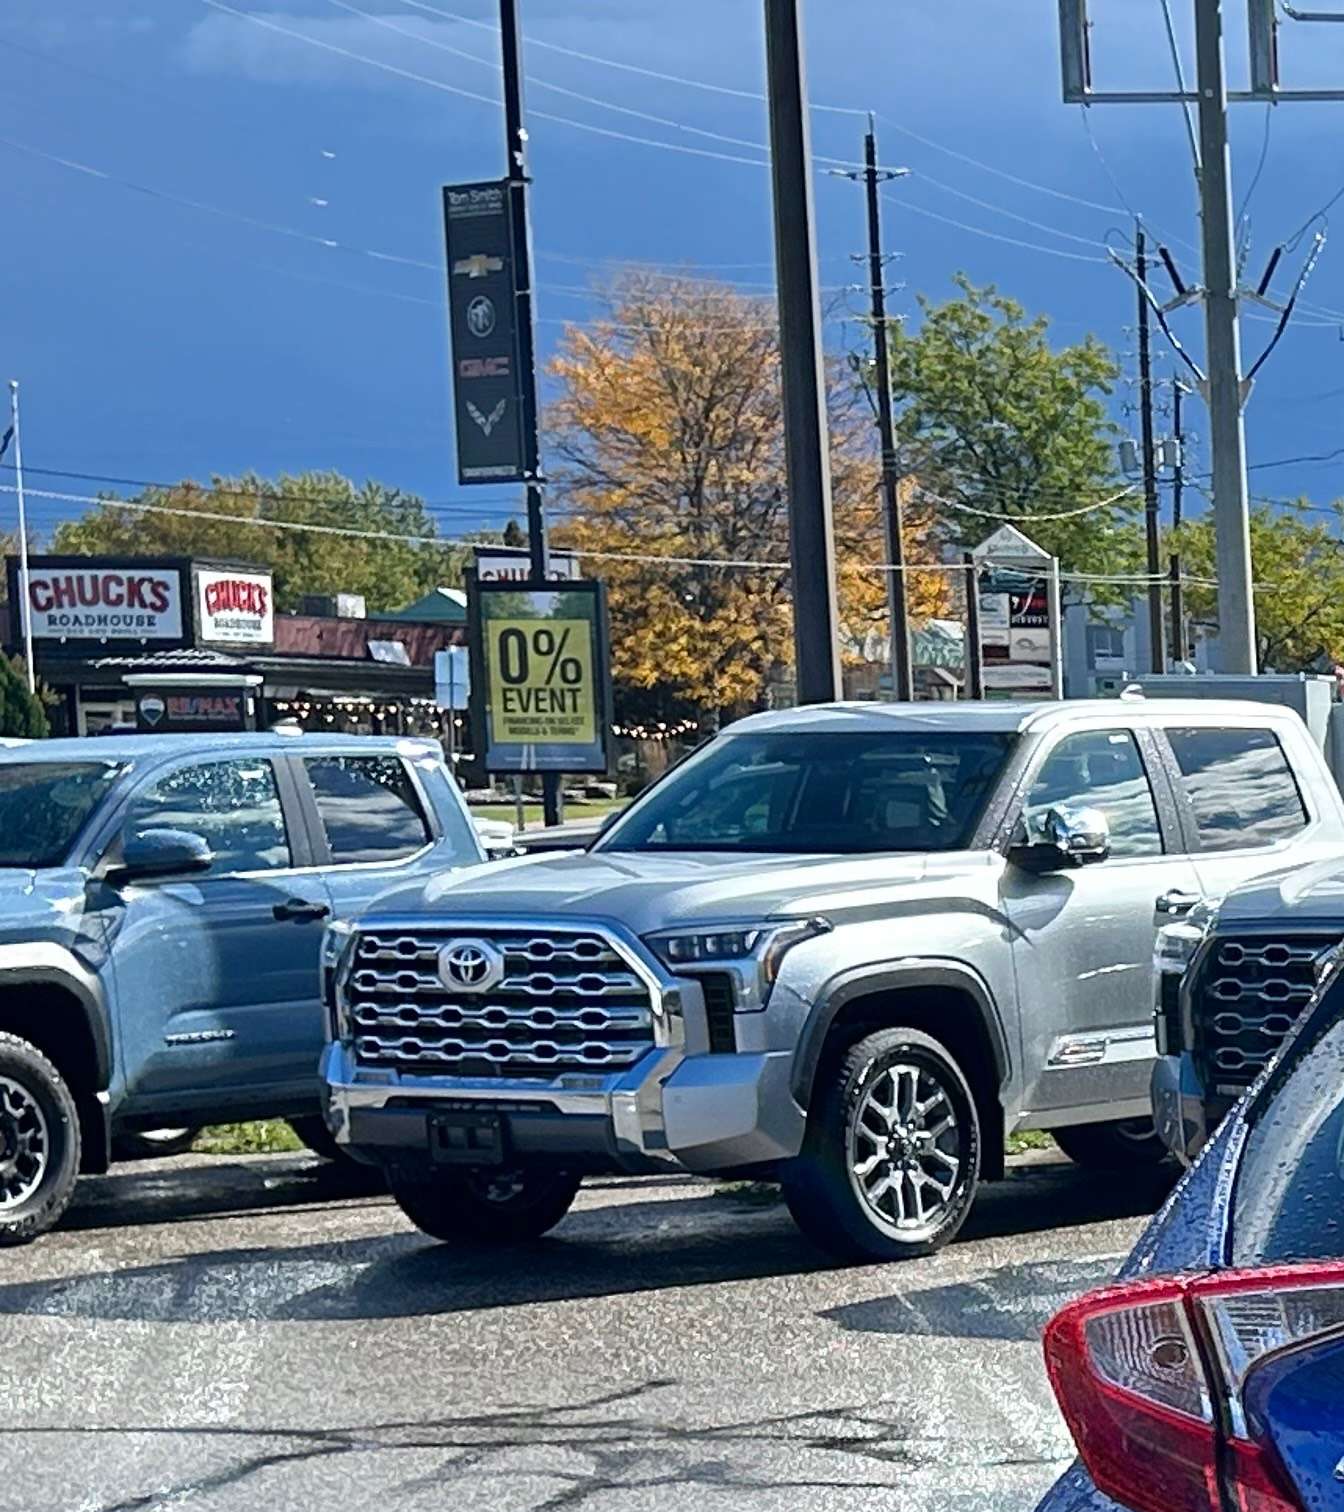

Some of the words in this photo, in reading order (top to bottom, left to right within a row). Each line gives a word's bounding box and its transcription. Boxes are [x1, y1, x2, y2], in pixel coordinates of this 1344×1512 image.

[460, 357, 510, 377] GMC
[29, 574, 171, 613] CHUCK'S
[47, 613, 157, 627] ROADHOUSE
[498, 627, 583, 685] 0%
[502, 687, 582, 713] EVENT
